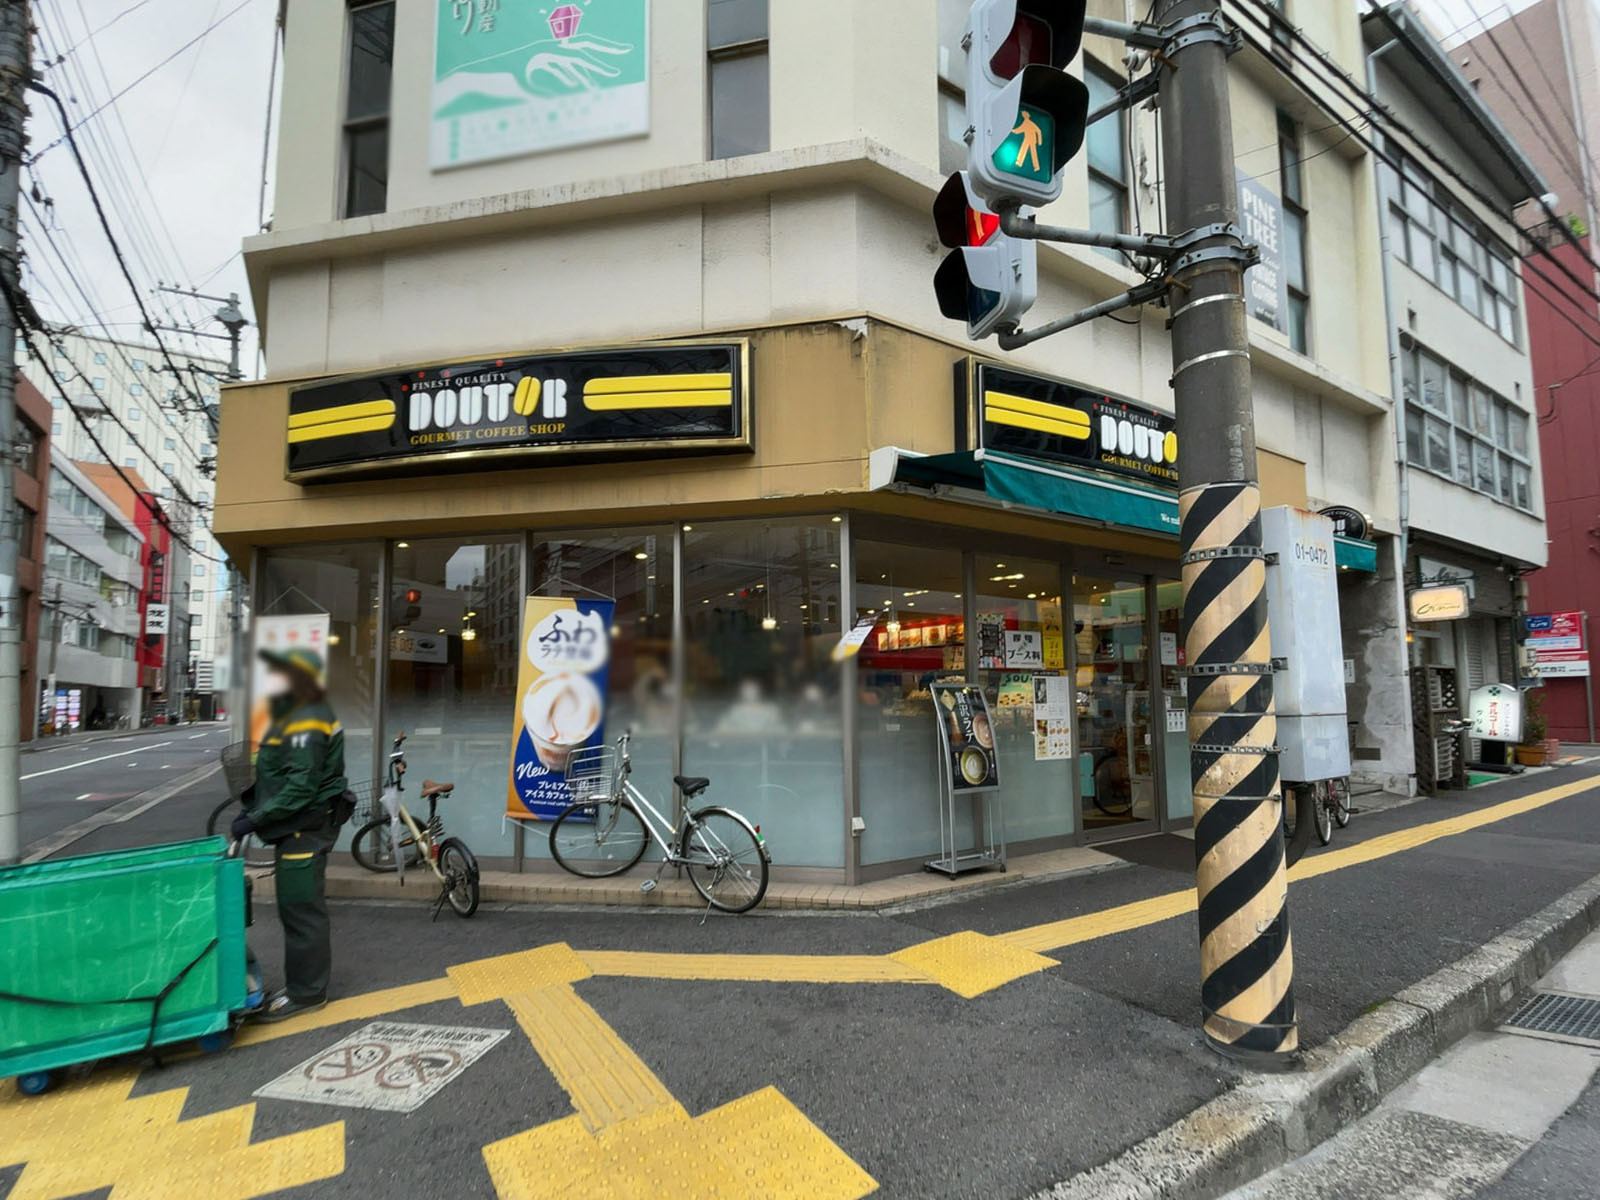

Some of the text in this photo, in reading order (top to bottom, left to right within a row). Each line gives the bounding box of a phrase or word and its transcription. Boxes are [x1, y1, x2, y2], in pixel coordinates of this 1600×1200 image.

[1241, 187, 1277, 229] PINE
[1243, 211, 1278, 253] TREE
[412, 372, 507, 391] FINEST QUALITY
[409, 376, 568, 431] DOUTOR
[1100, 405, 1159, 429] FINEST QUALITY
[410, 423, 565, 445] GOURMET COFFEE SHOP
[1101, 414, 1178, 463] DOUTO
[1101, 453, 1141, 470] GOURMET
[1295, 543, 1328, 565] 01-0472
[539, 614, 597, 645] ふわ
[541, 644, 592, 661] ラテ
[1004, 674, 1031, 684] SOU
[516, 760, 550, 780] New
[538, 781, 571, 791] プレミアム
